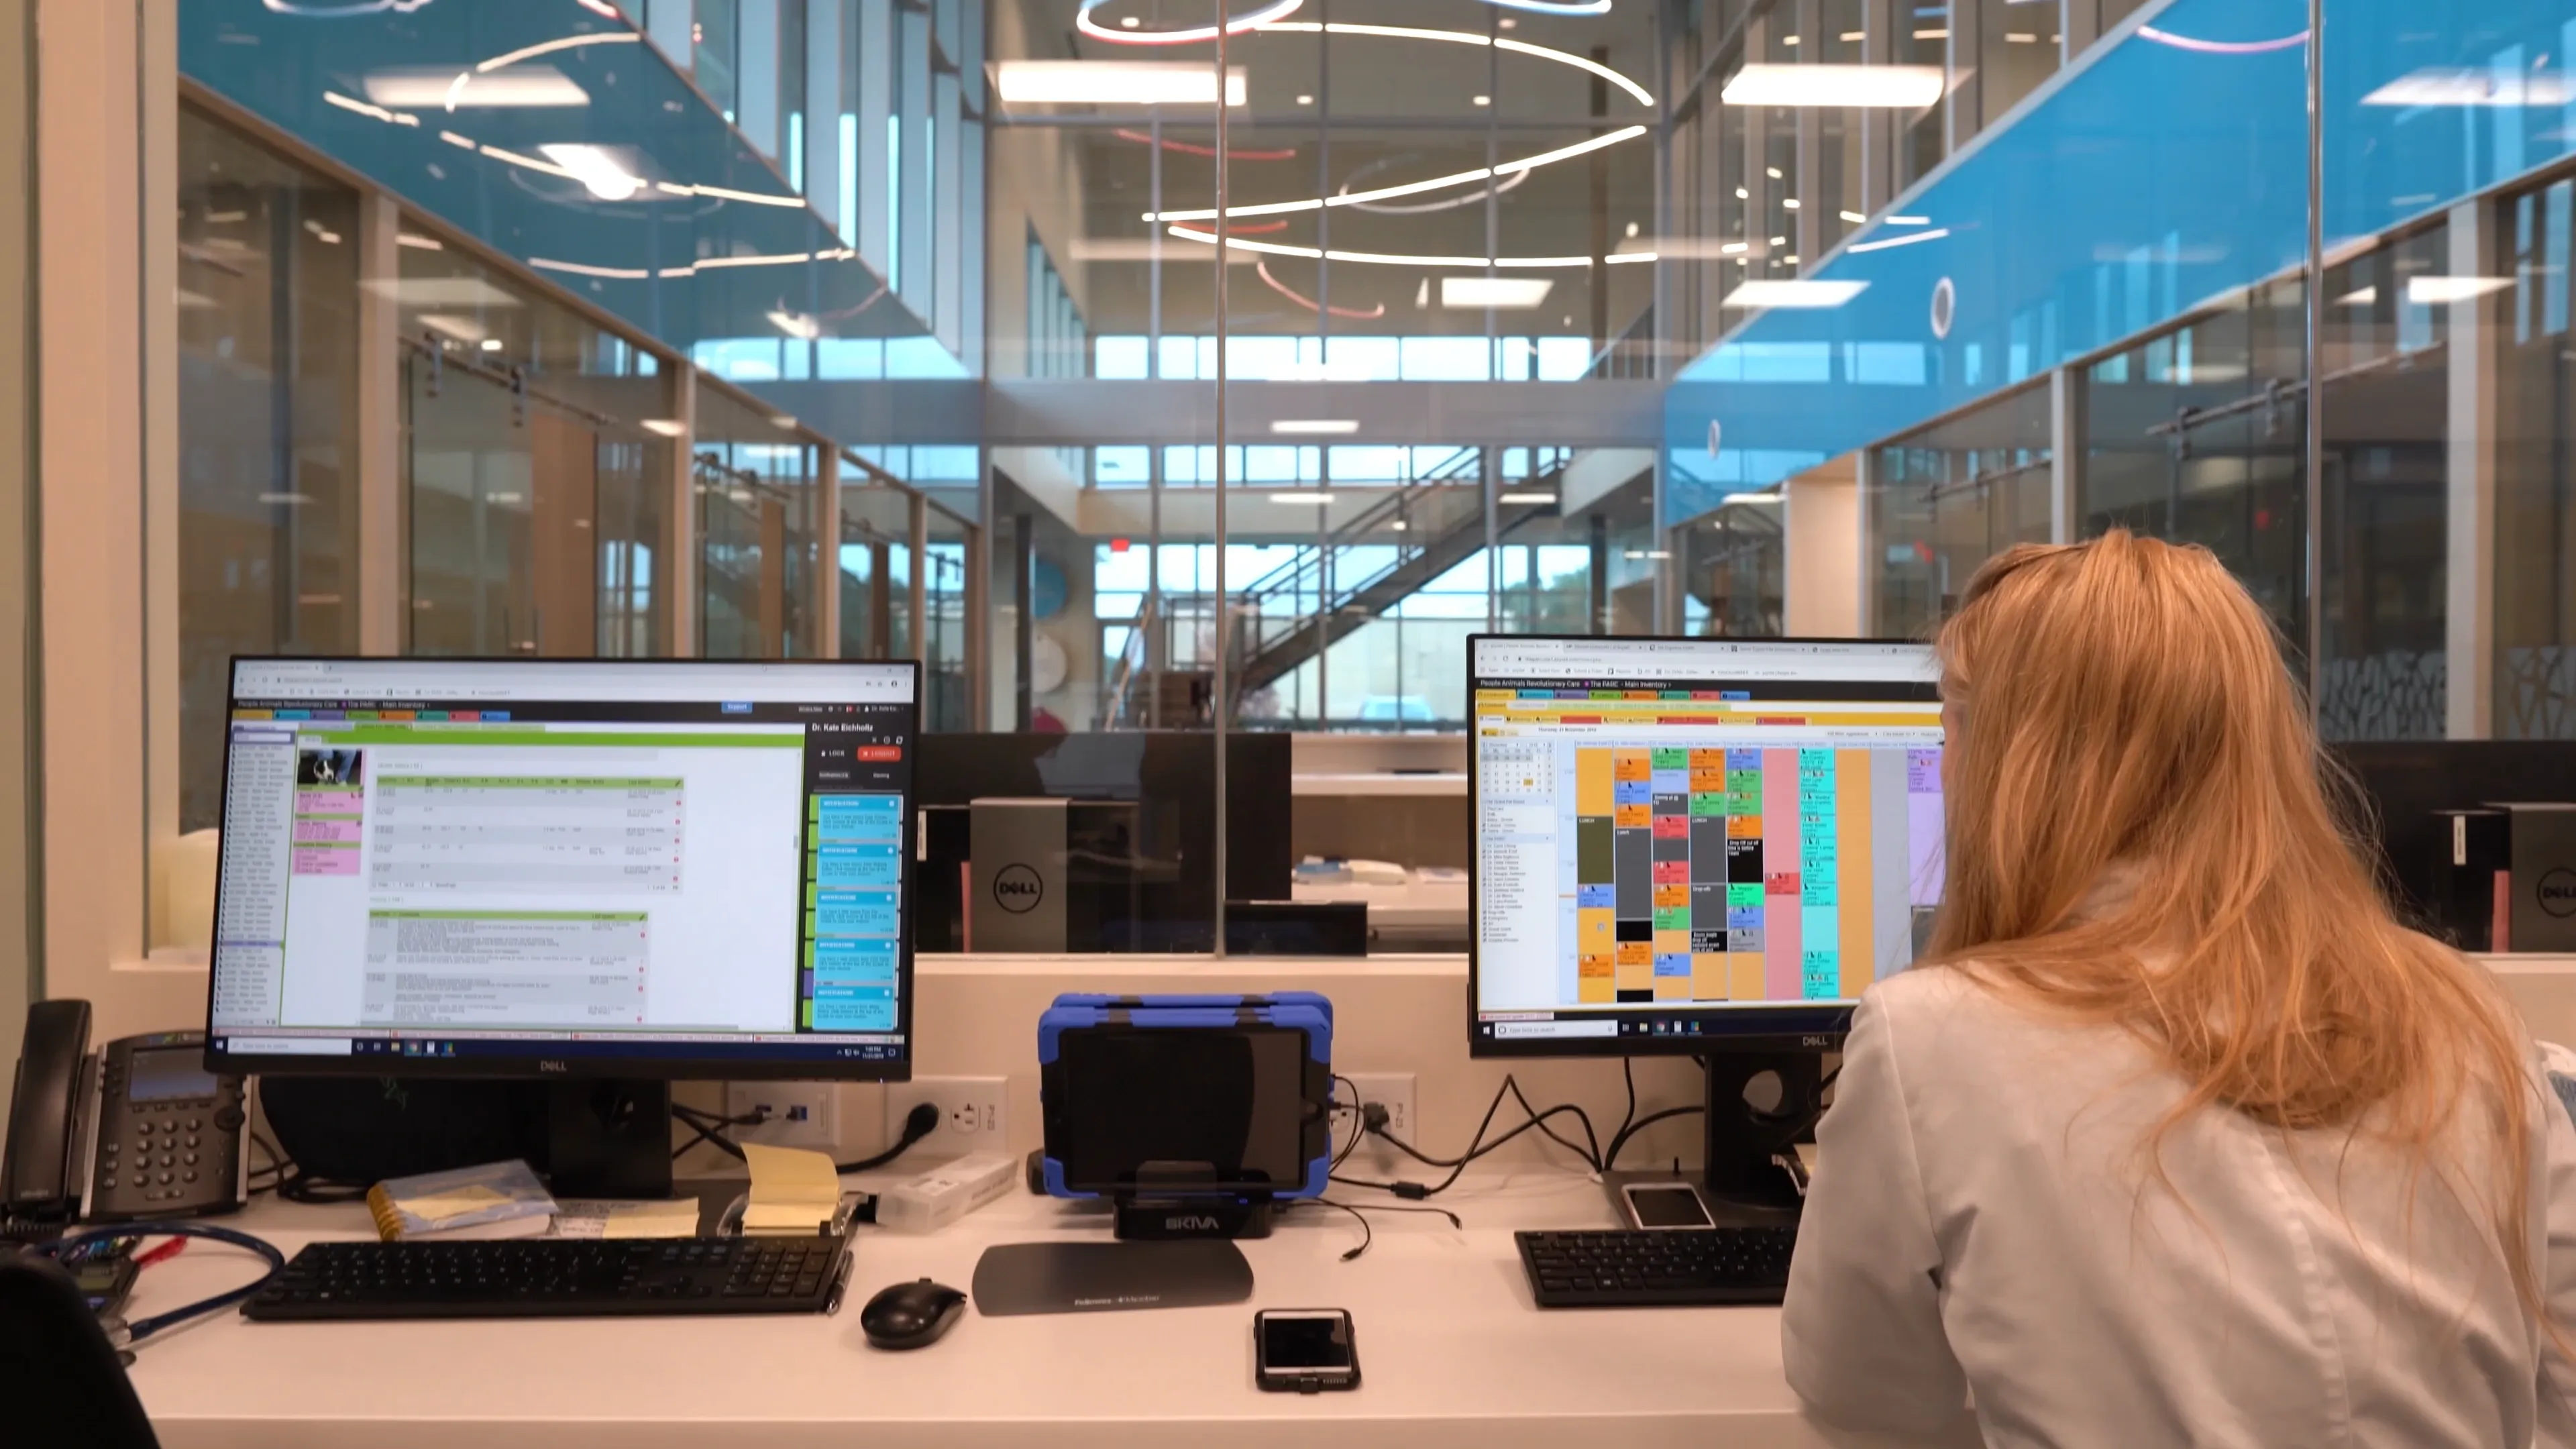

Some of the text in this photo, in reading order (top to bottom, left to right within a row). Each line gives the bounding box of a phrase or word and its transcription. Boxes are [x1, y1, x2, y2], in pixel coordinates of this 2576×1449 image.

[1480, 679, 1501, 688] People
[1503, 679, 1525, 687] Animals
[1526, 680, 1566, 688] Revolutionary
[1639, 681, 1667, 689] Inventory
[811, 723, 822, 733] Dr.
[823, 723, 839, 732] Kate
[999, 881, 1038, 895] DELL
[1509, 1026, 1522, 1034] Type
[1803, 1036, 1828, 1046] DELL
[541, 1060, 567, 1072] DELL
